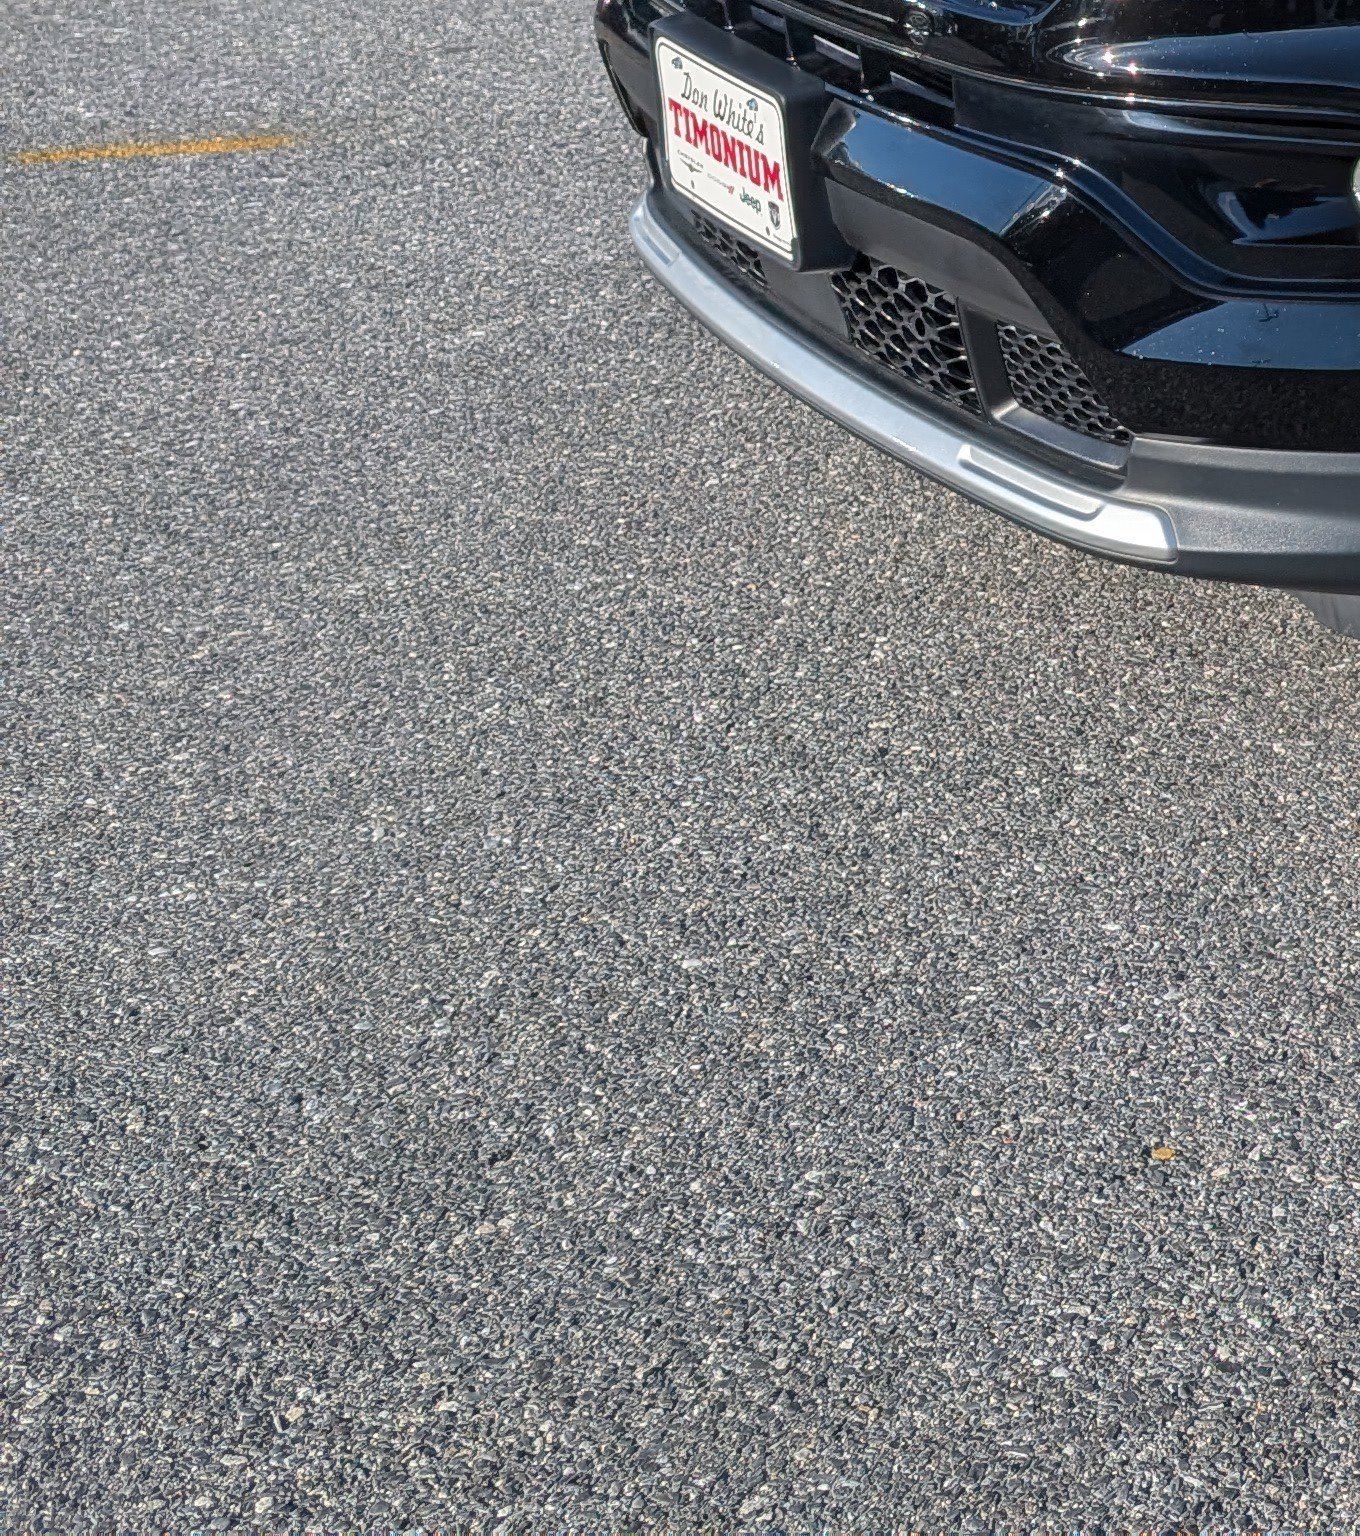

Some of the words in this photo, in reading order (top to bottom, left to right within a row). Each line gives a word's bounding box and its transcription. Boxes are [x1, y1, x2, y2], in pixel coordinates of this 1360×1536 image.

[668, 97, 784, 202] TIMONIUM
[681, 72, 708, 112] Don
[713, 89, 764, 145] White's
